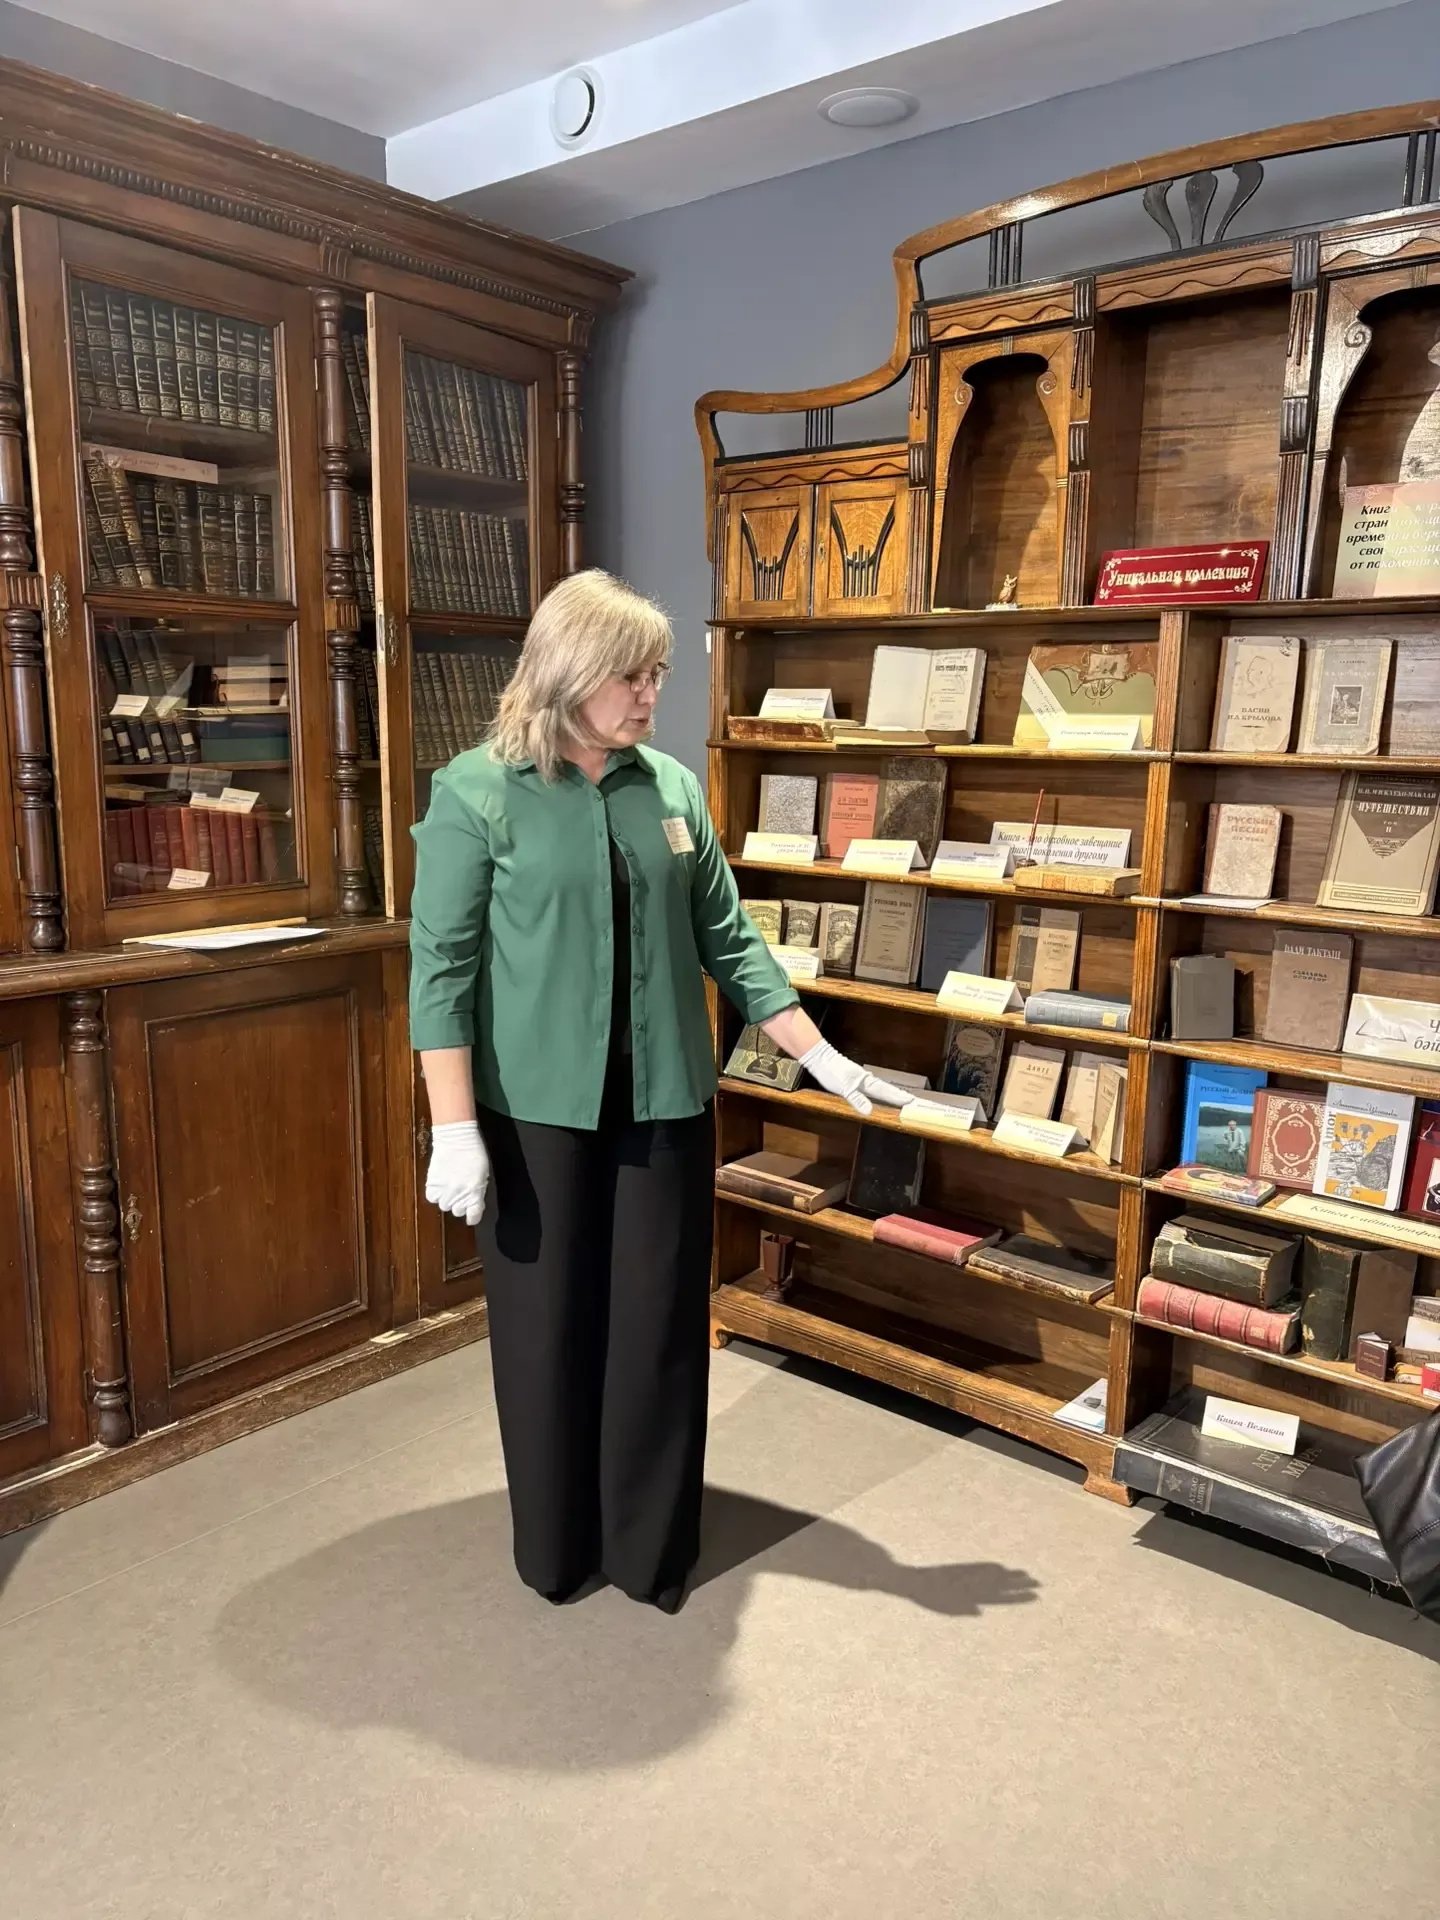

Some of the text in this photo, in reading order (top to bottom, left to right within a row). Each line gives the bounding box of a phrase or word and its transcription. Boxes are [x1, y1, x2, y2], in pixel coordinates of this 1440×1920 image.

[1349, 561, 1364, 570] от
[1108, 566, 1249, 587] Уникальная коллекция
[1358, 801, 1430, 816] ПУТЕШЕСТВИЯ
[998, 831, 1021, 842] Книга
[1080, 836, 1122, 850] завещание
[1033, 848, 1073, 858] поколения
[1074, 847, 1109, 864] другому
[1307, 946, 1341, 960] ТАКТАШ
[1310, 1205, 1349, 1218] Книга
